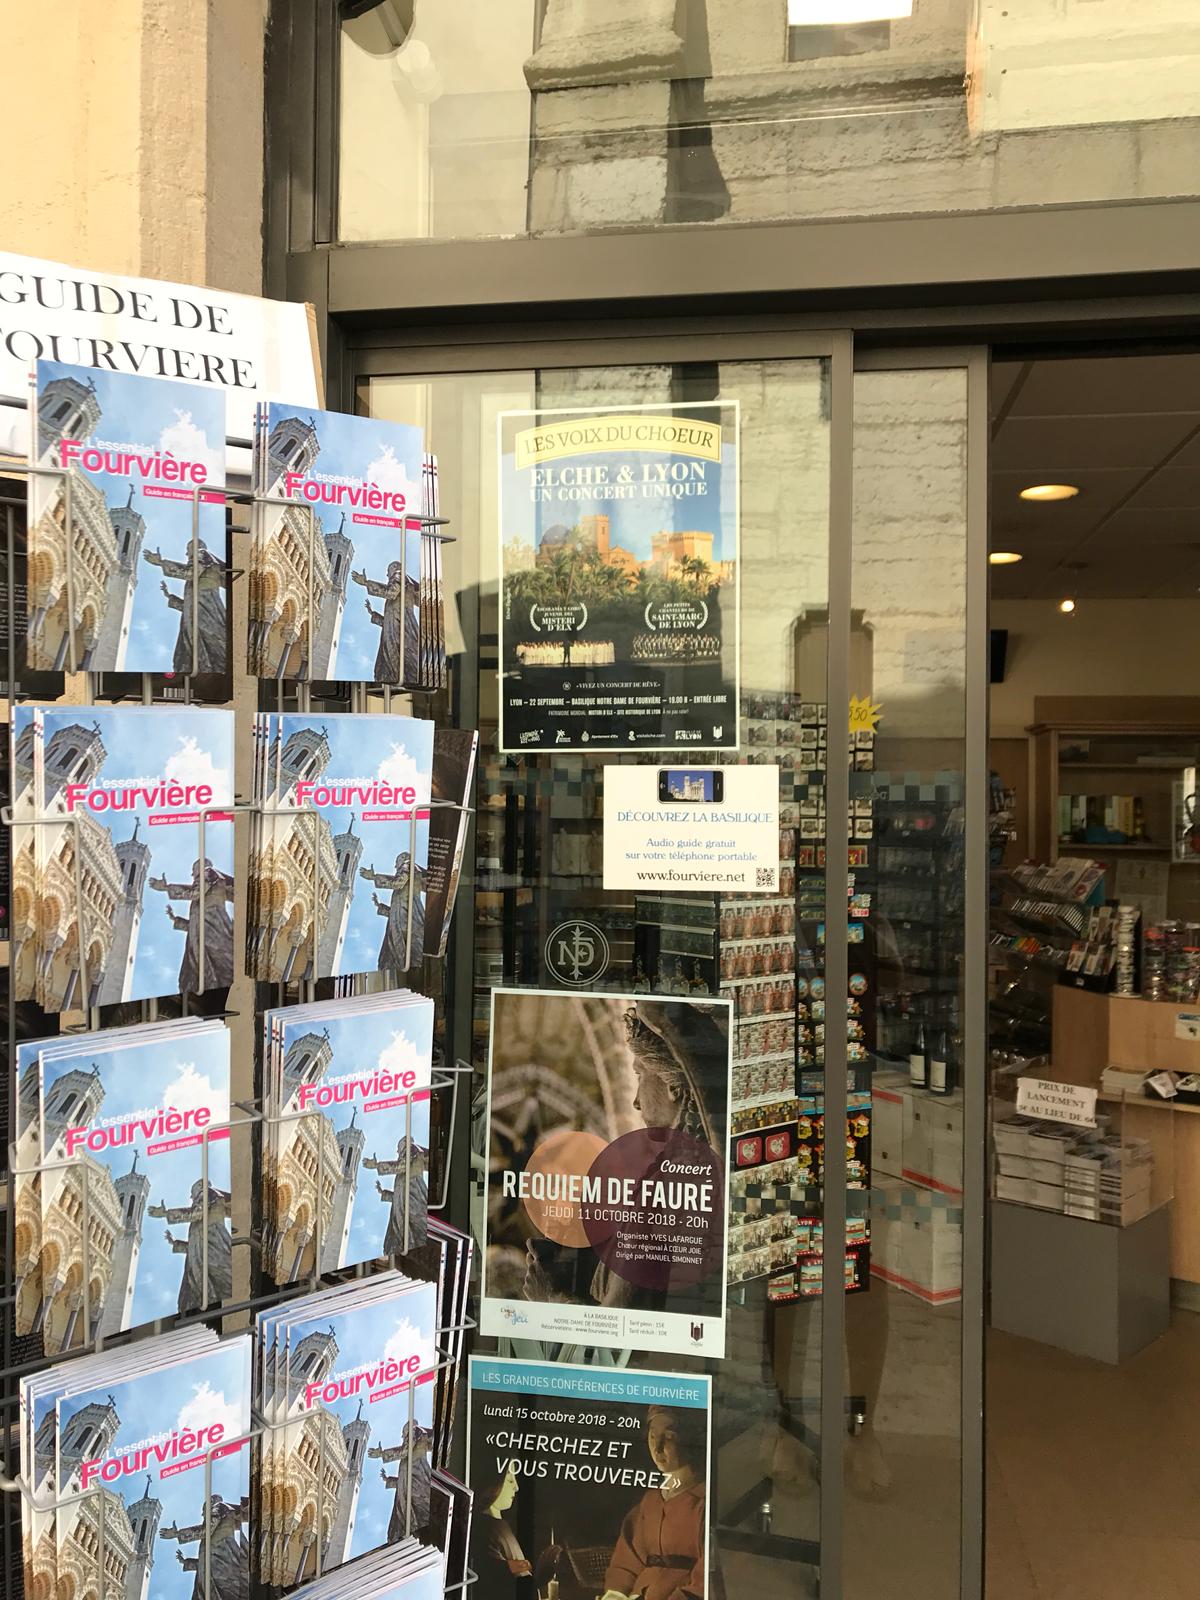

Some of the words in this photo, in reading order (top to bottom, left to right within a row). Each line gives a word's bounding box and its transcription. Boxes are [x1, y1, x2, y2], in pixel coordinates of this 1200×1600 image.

[0, 271, 158, 323] GUIDE
[168, 297, 234, 335] DE
[0, 327, 257, 390] OURVIERE
[524, 433, 555, 455] LES
[558, 427, 603, 448] VOIX
[607, 425, 632, 442] DU
[635, 425, 714, 448] CHOEUR
[60, 438, 208, 485] Fourvière
[530, 466, 609, 488] ELCHE
[616, 464, 634, 484] &
[643, 461, 706, 482] LYON
[286, 471, 407, 513] Fourvière
[530, 487, 552, 502] UN
[557, 485, 637, 501] CONCERT
[642, 482, 708, 499] UNIQUE
[541, 616, 576, 625] MISTERI
[547, 624, 572, 632] D'ELX
[651, 612, 703, 622] SAINT-MARC
[658, 621, 671, 629] DE
[673, 620, 696, 629] LYON
[693, 694, 712, 704] ENTRÉE
[66, 778, 213, 813] Fourvière
[296, 780, 417, 807] Fourvière
[617, 809, 690, 822] DÉCOUVREZ
[692, 812, 709, 823] LA
[711, 812, 774, 824] BASILIQUE
[646, 838, 675, 848] Audio
[677, 838, 703, 850] guide
[705, 839, 736, 850] gratuit
[625, 852, 641, 860] sur
[642, 851, 666, 860] votre
[669, 850, 715, 863] téléphone
[718, 851, 758, 862] portable
[637, 869, 746, 883] www.fourviere.net
[299, 1069, 416, 1110] Fourvière
[1027, 1091, 1086, 1109] LANCEMENT
[1038, 1081, 1060, 1093] PRIX
[1062, 1085, 1076, 1095] DE
[1044, 1108, 1067, 1119] LIEU
[1069, 1112, 1083, 1122] DE
[66, 1106, 211, 1157] Fourvière
[660, 1159, 713, 1176] Concert
[502, 1169, 601, 1204] REQUIEM
[607, 1177, 635, 1207] DE
[641, 1179, 713, 1213] FAURÉ
[541, 1205, 574, 1219] JEUDI
[577, 1208, 591, 1220] 11
[594, 1209, 644, 1224] OCTOBRE
[647, 1213, 676, 1227] 2018
[686, 1215, 709, 1229] 20h
[616, 1231, 649, 1242] Organiste
[649, 1233, 667, 1242] YVES
[668, 1234, 703, 1245] LAFARGUE
[638, 1242, 663, 1253] régional
[687, 1246, 702, 1255] JOIE
[615, 1251, 633, 1261] Dirigé
[634, 1253, 645, 1262] par
[646, 1253, 671, 1263] MANUEL
[672, 1255, 703, 1265] SIMONNET
[305, 1355, 421, 1409] Fourvière
[482, 1372, 501, 1384] LES
[503, 1374, 549, 1388] GRANDES
[551, 1377, 625, 1395] CONFÉRENCES
[627, 1385, 640, 1396] DE
[643, 1385, 700, 1401] FOURVIÈRE
[483, 1404, 513, 1418] lundi
[516, 1407, 528, 1419] 15
[530, 1408, 576, 1424] octobre
[577, 1413, 607, 1426] 2018
[617, 1416, 641, 1429] 20h
[81, 1423, 225, 1489] Fourvière
[485, 1431, 602, 1458] «CHERCHEZ
[607, 1441, 632, 1459] ET
[496, 1457, 548, 1479] VOUS
[554, 1462, 681, 1490] TROUVEREZ»
